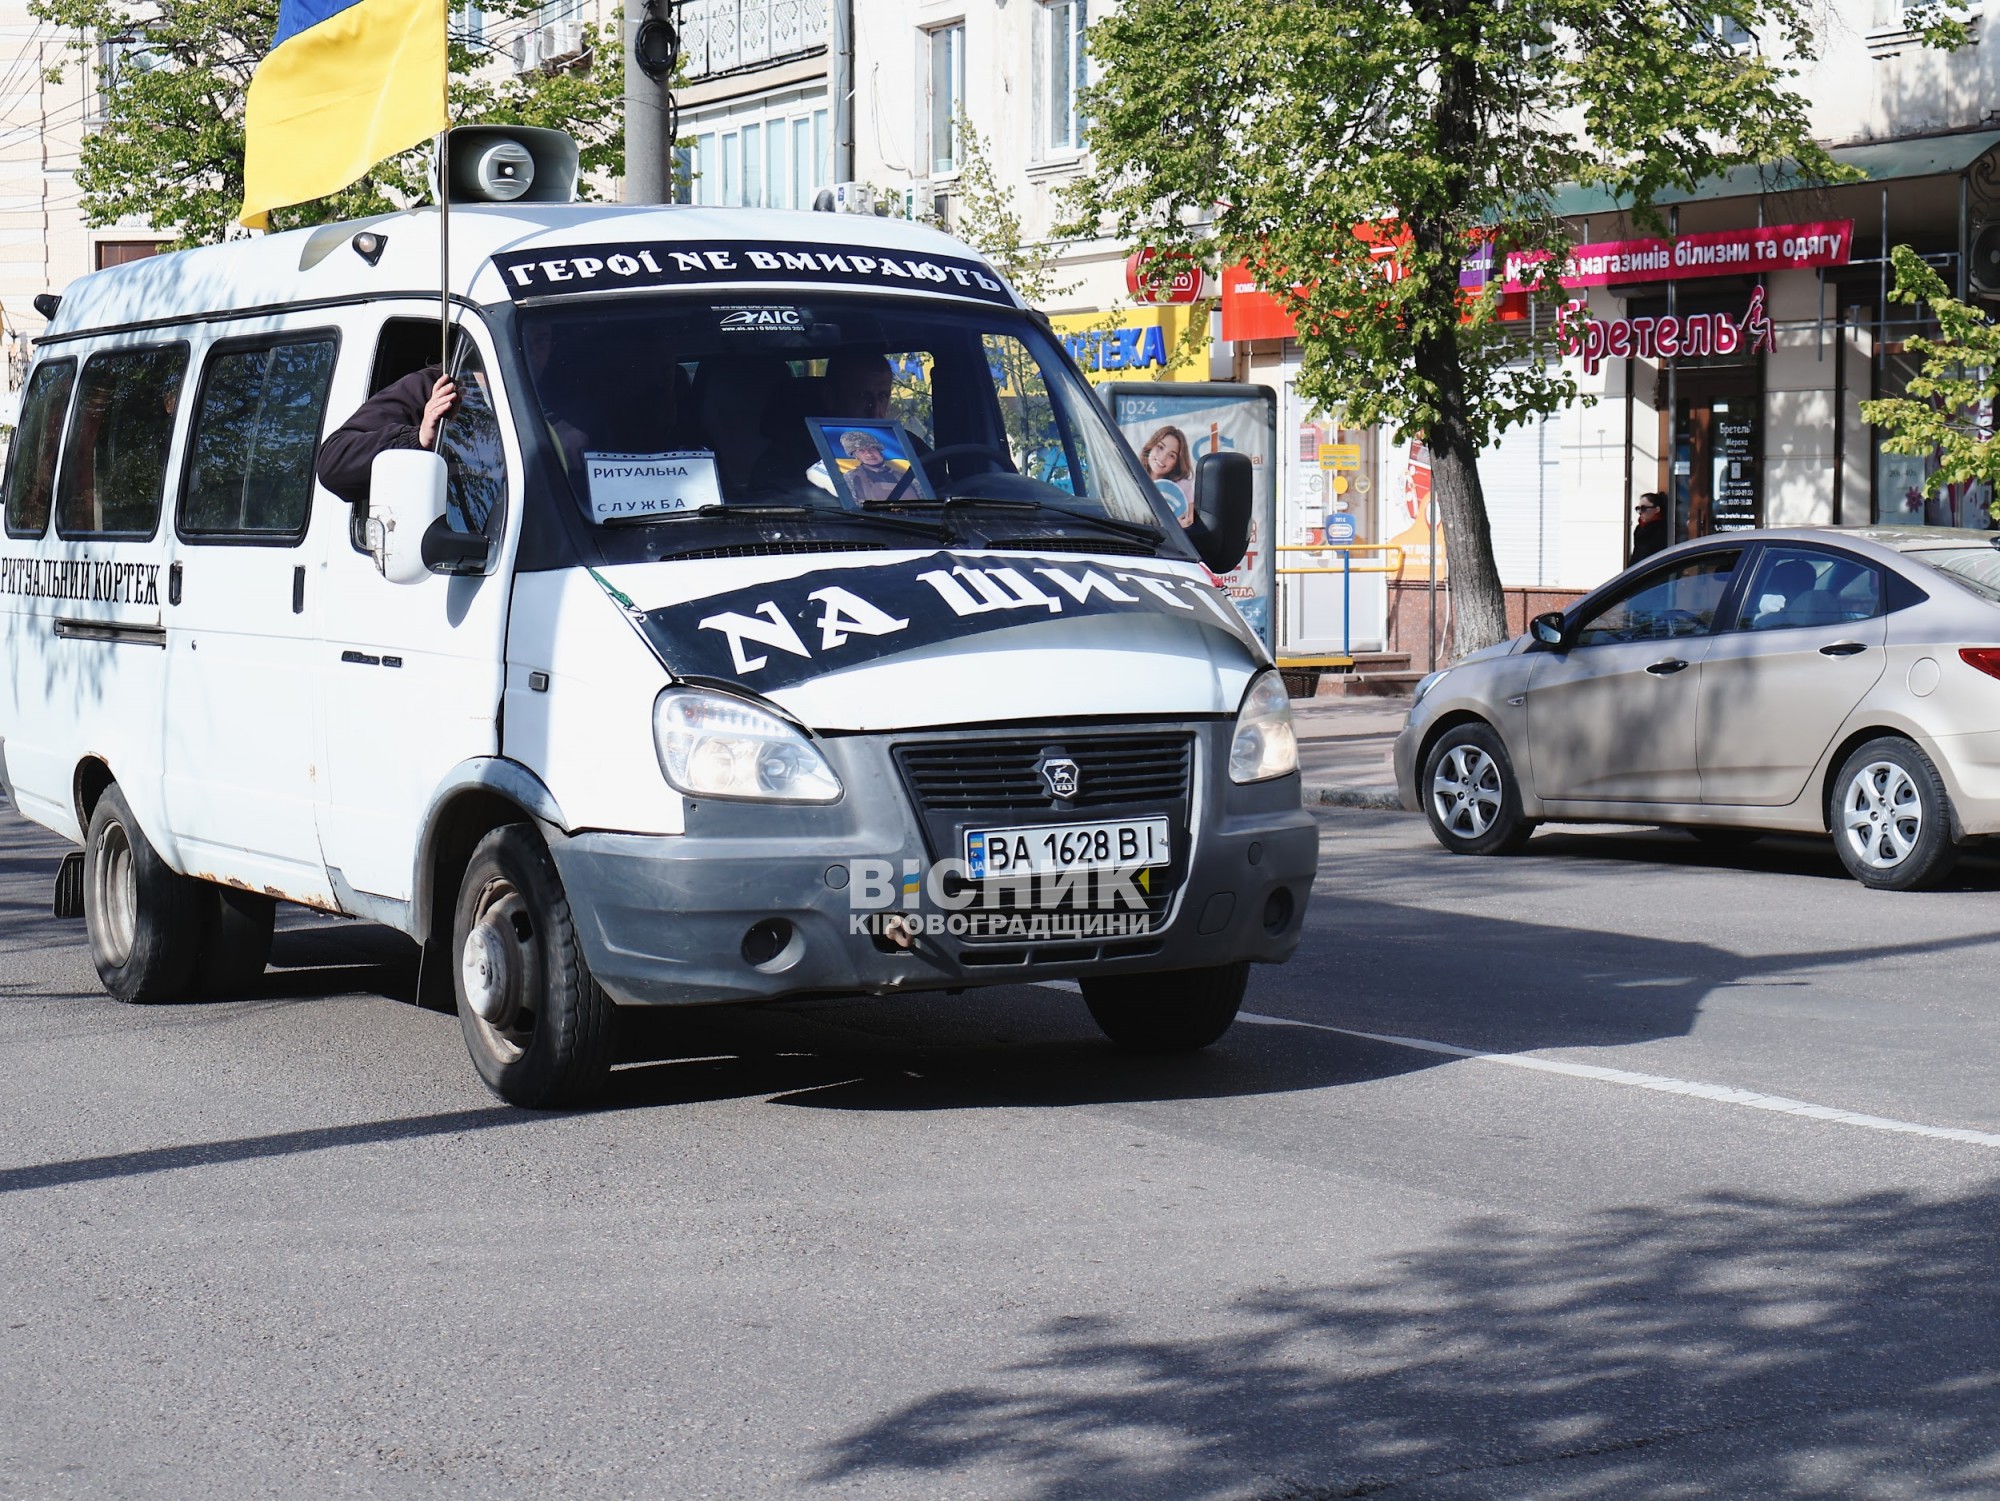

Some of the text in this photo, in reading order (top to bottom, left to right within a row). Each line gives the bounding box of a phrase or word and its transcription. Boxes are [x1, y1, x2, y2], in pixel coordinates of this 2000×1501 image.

[508, 250, 662, 286] ГЕРОЇ
[744, 251, 1001, 292] ВМИРАЮТЬ
[1581, 245, 1669, 276] магазинів
[1675, 241, 1749, 267] білизни
[1755, 241, 1777, 260] та
[1783, 234, 1841, 261] одягу
[758, 311, 799, 325] AIC
[1555, 299, 1738, 375] Бретель
[1120, 400, 1157, 415] 1024
[594, 466, 688, 479] РИТУАЛЬНА
[597, 498, 686, 513] СЛУЖБА
[1, 553, 160, 605] РИТУАЛЬНИЙ КОРТЕЖ
[916, 565, 1241, 634] ЩИТІ
[969, 861, 985, 872] UA
[987, 826, 1152, 870] BA 1628 BI
